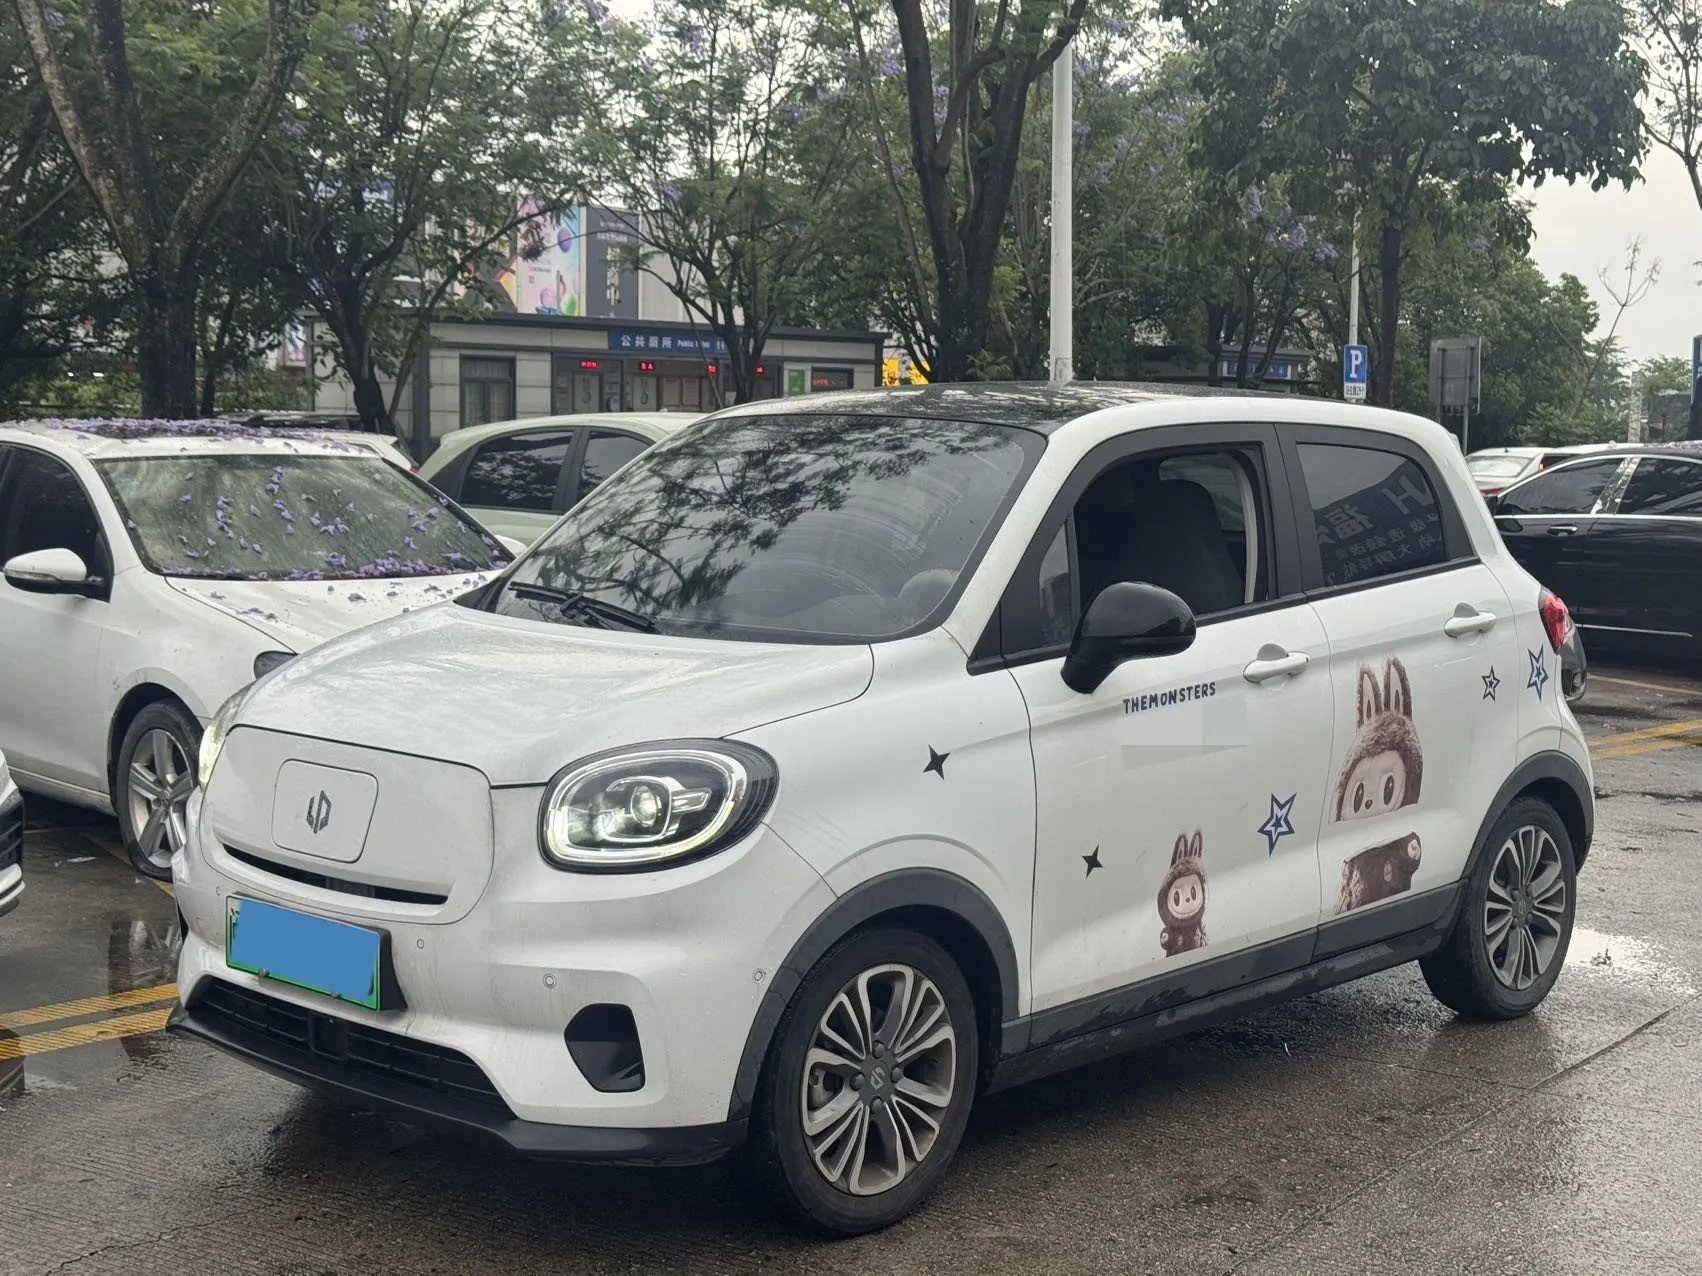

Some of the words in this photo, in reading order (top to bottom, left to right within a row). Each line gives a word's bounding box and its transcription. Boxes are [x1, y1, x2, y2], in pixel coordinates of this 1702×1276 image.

[621, 335, 672, 349] 公共厕所
[1350, 350, 1362, 378] P
[1122, 681, 1216, 714] THEMONSTERS
